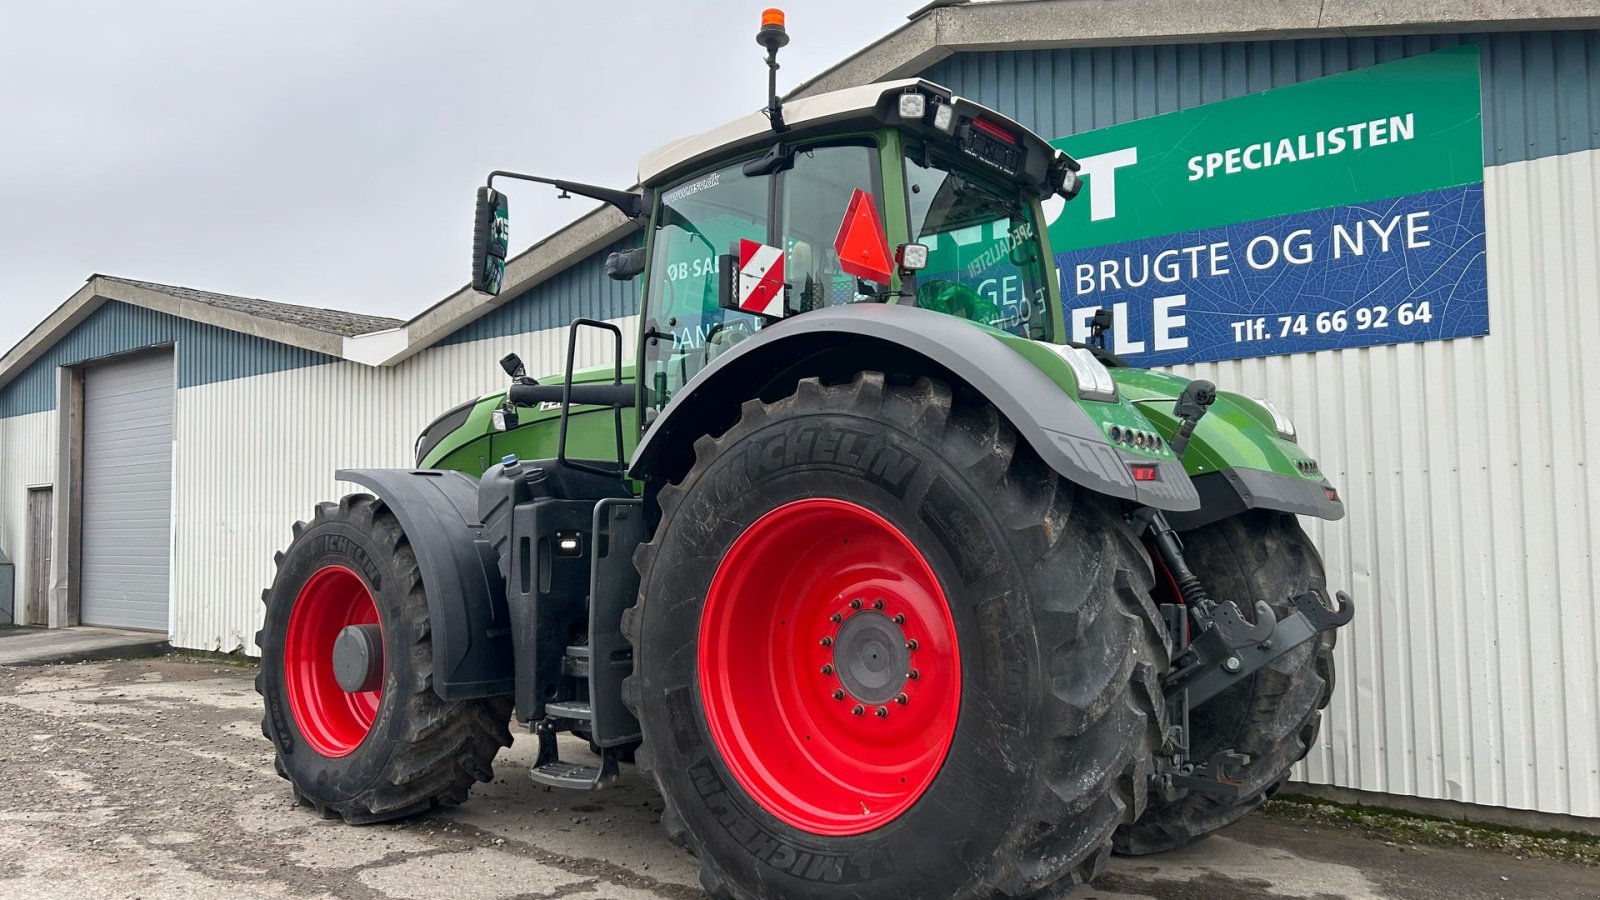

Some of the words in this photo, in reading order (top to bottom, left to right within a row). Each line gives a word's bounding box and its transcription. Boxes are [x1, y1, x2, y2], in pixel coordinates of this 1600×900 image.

[1187, 112, 1415, 182] SPECIALISTEN
[1076, 241, 1229, 295] BRUGTE
[1246, 229, 1314, 270] OG
[1333, 211, 1431, 260] NYE
[1231, 317, 1270, 343] Tlf.
[1278, 315, 1309, 338] 74
[1316, 310, 1347, 334] 66
[1356, 305, 1388, 330] 92
[1397, 301, 1432, 326] 64
[689, 763, 847, 884] MICHELIN
